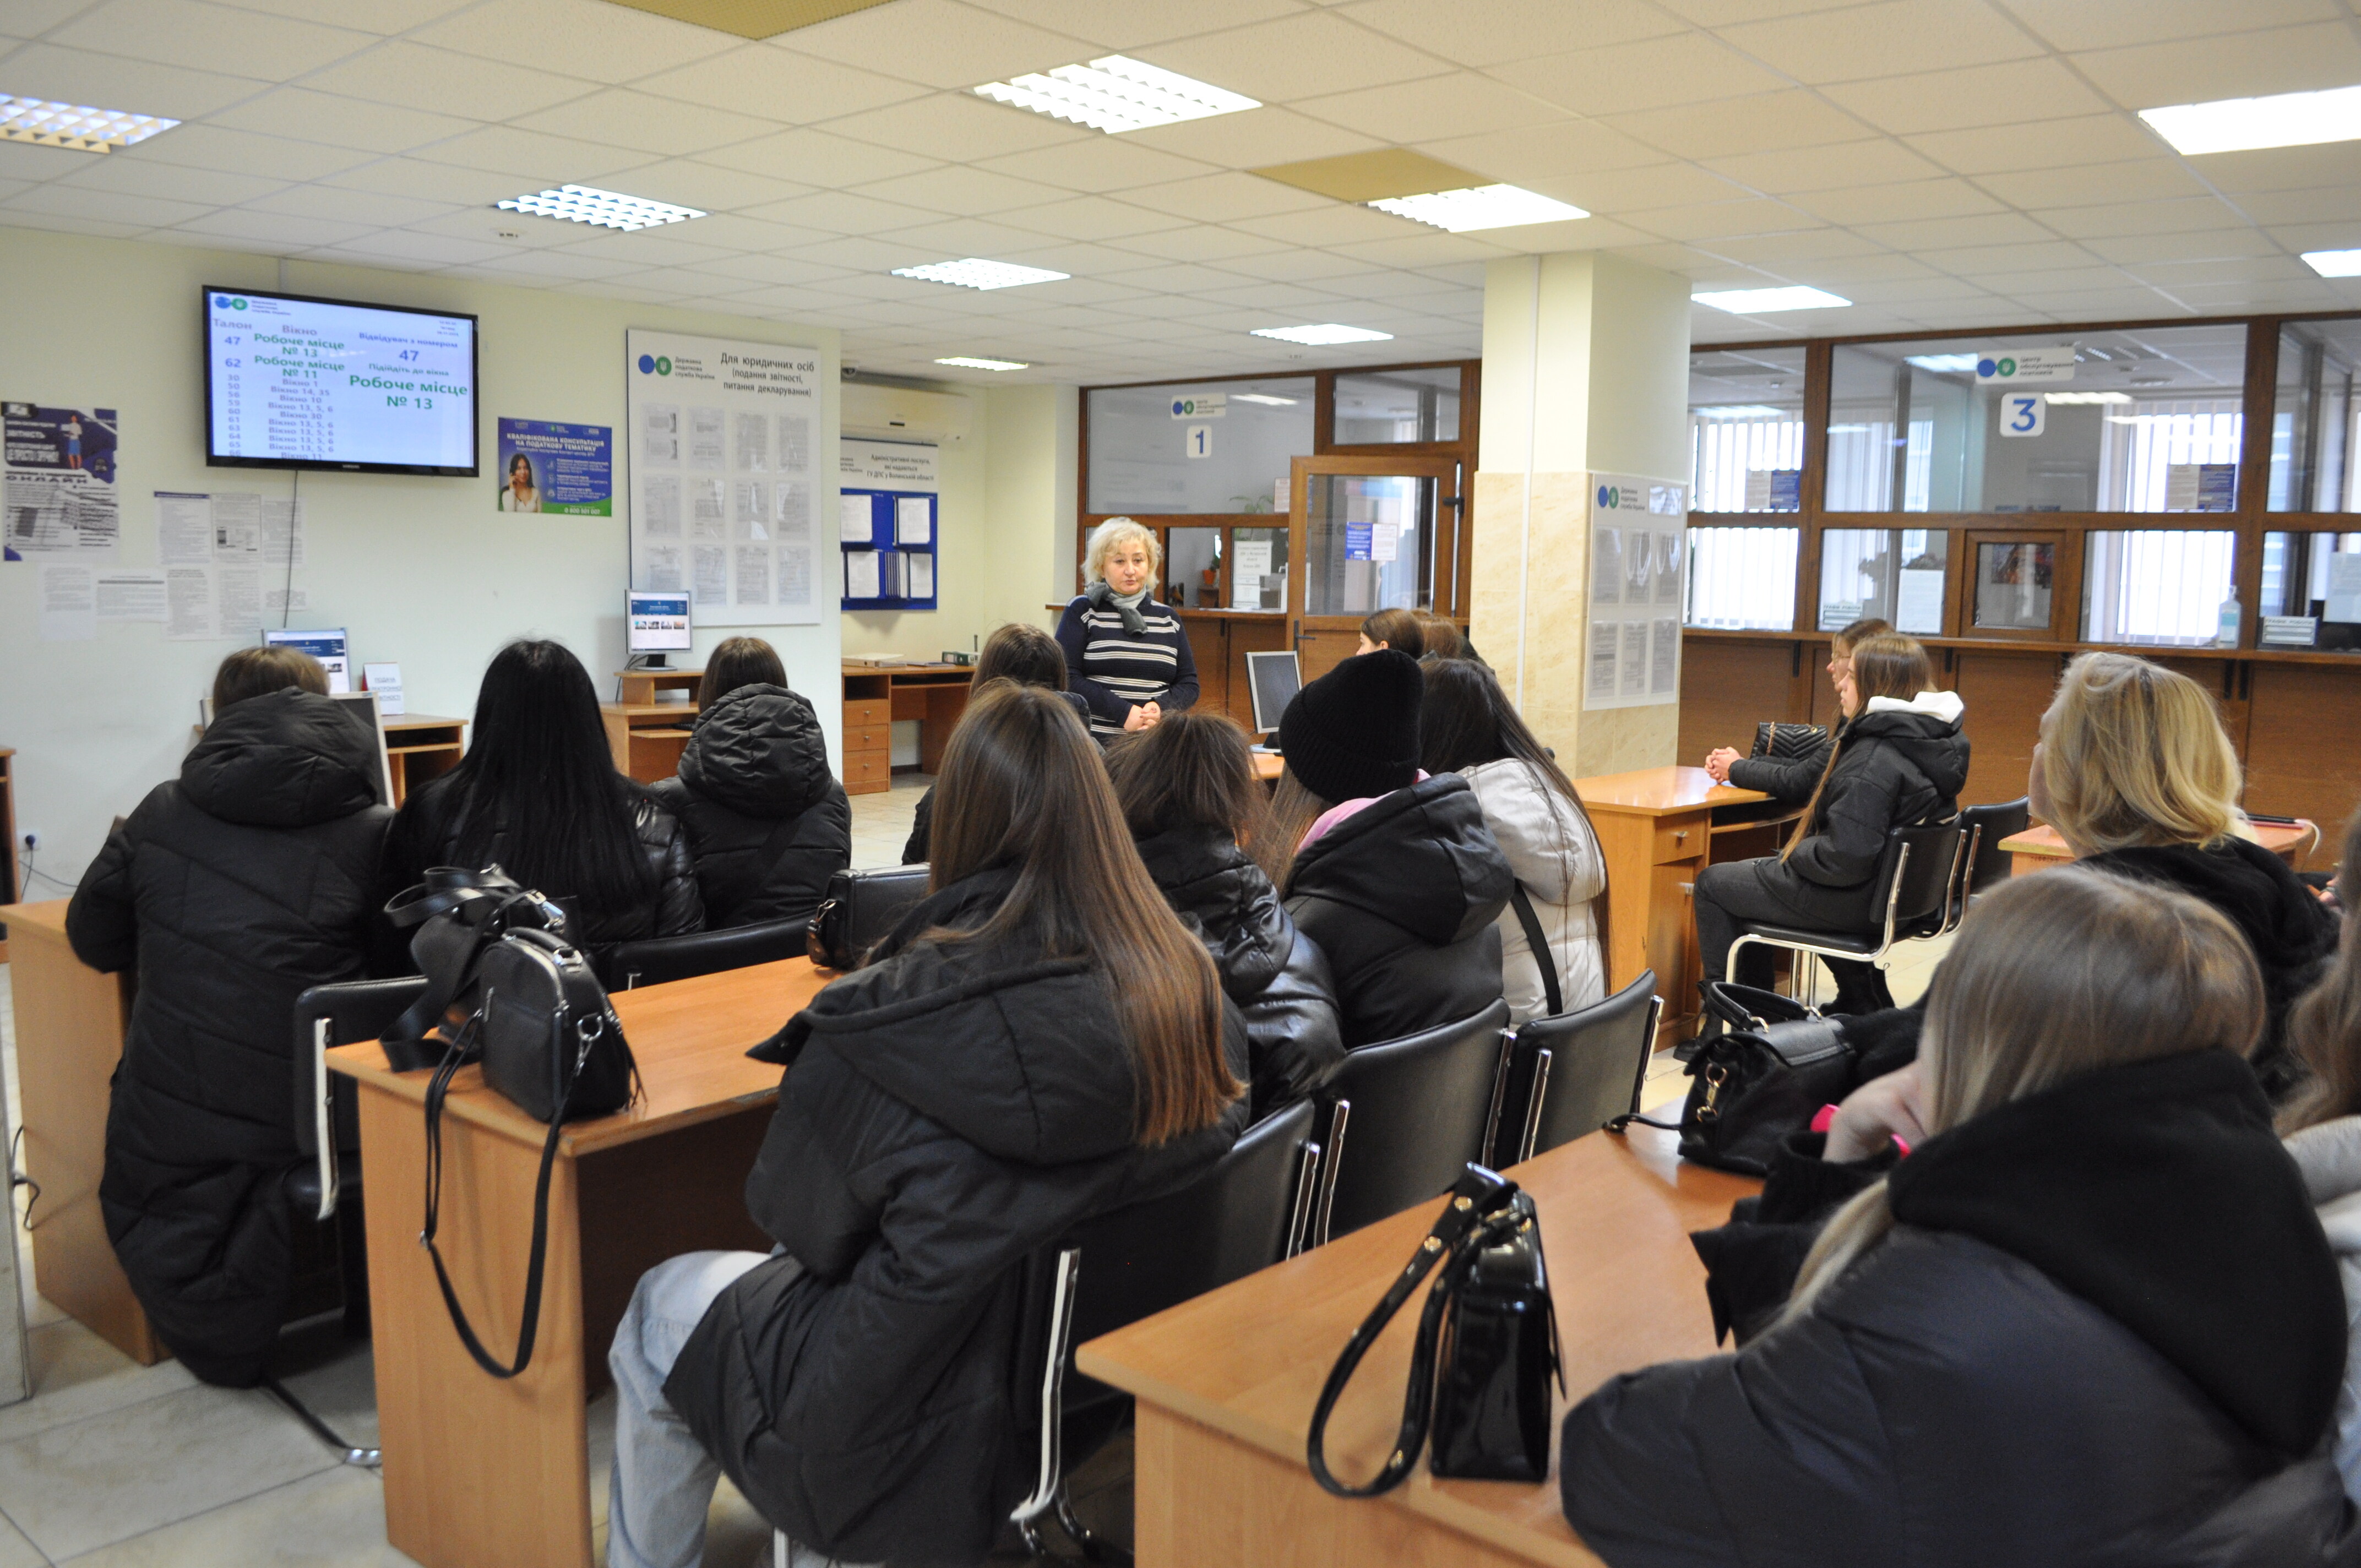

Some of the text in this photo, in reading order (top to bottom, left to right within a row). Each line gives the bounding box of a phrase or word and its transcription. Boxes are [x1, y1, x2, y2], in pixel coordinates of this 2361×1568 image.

[213, 318, 317, 335] Талон Вікно
[225, 336, 241, 346] 47
[254, 333, 345, 350] Робоче місце
[359, 331, 407, 343] Відвідувач
[418, 339, 458, 349] номером
[282, 346, 318, 358] № 13
[399, 350, 419, 361] 47
[225, 358, 241, 368] 62
[254, 355, 345, 372] Робоче місце
[721, 352, 814, 372] Для юридичних осіб
[282, 368, 318, 379] № 11
[368, 363, 410, 373] Підійдіть
[732, 368, 803, 384] (подання звітності,
[282, 378, 309, 386] Вікно
[350, 375, 467, 397] Робоче місце
[270, 385, 298, 394] Вікно
[723, 382, 812, 397] питання декларування)
[280, 394, 307, 403] Вікно
[387, 395, 433, 410] № 13
[268, 402, 296, 410] Вікно
[280, 411, 308, 420] Вікно
[2011, 399, 2036, 432] 3
[268, 418, 296, 427] Вікно
[507, 433, 604, 447] КВАЛІФІКОВАНА КОНСУЛЬТАЦІЯ
[1195, 429, 1204, 454] 1
[269, 443, 297, 451] Вікно
[526, 440, 563, 450] ПОДАТКОВУ
[564, 444, 596, 453] ТЕМАТИКУ
[281, 451, 308, 460] Вікно
[871, 454, 910, 462] Адміністративні
[5, 475, 87, 484] ОНЛАЙН
